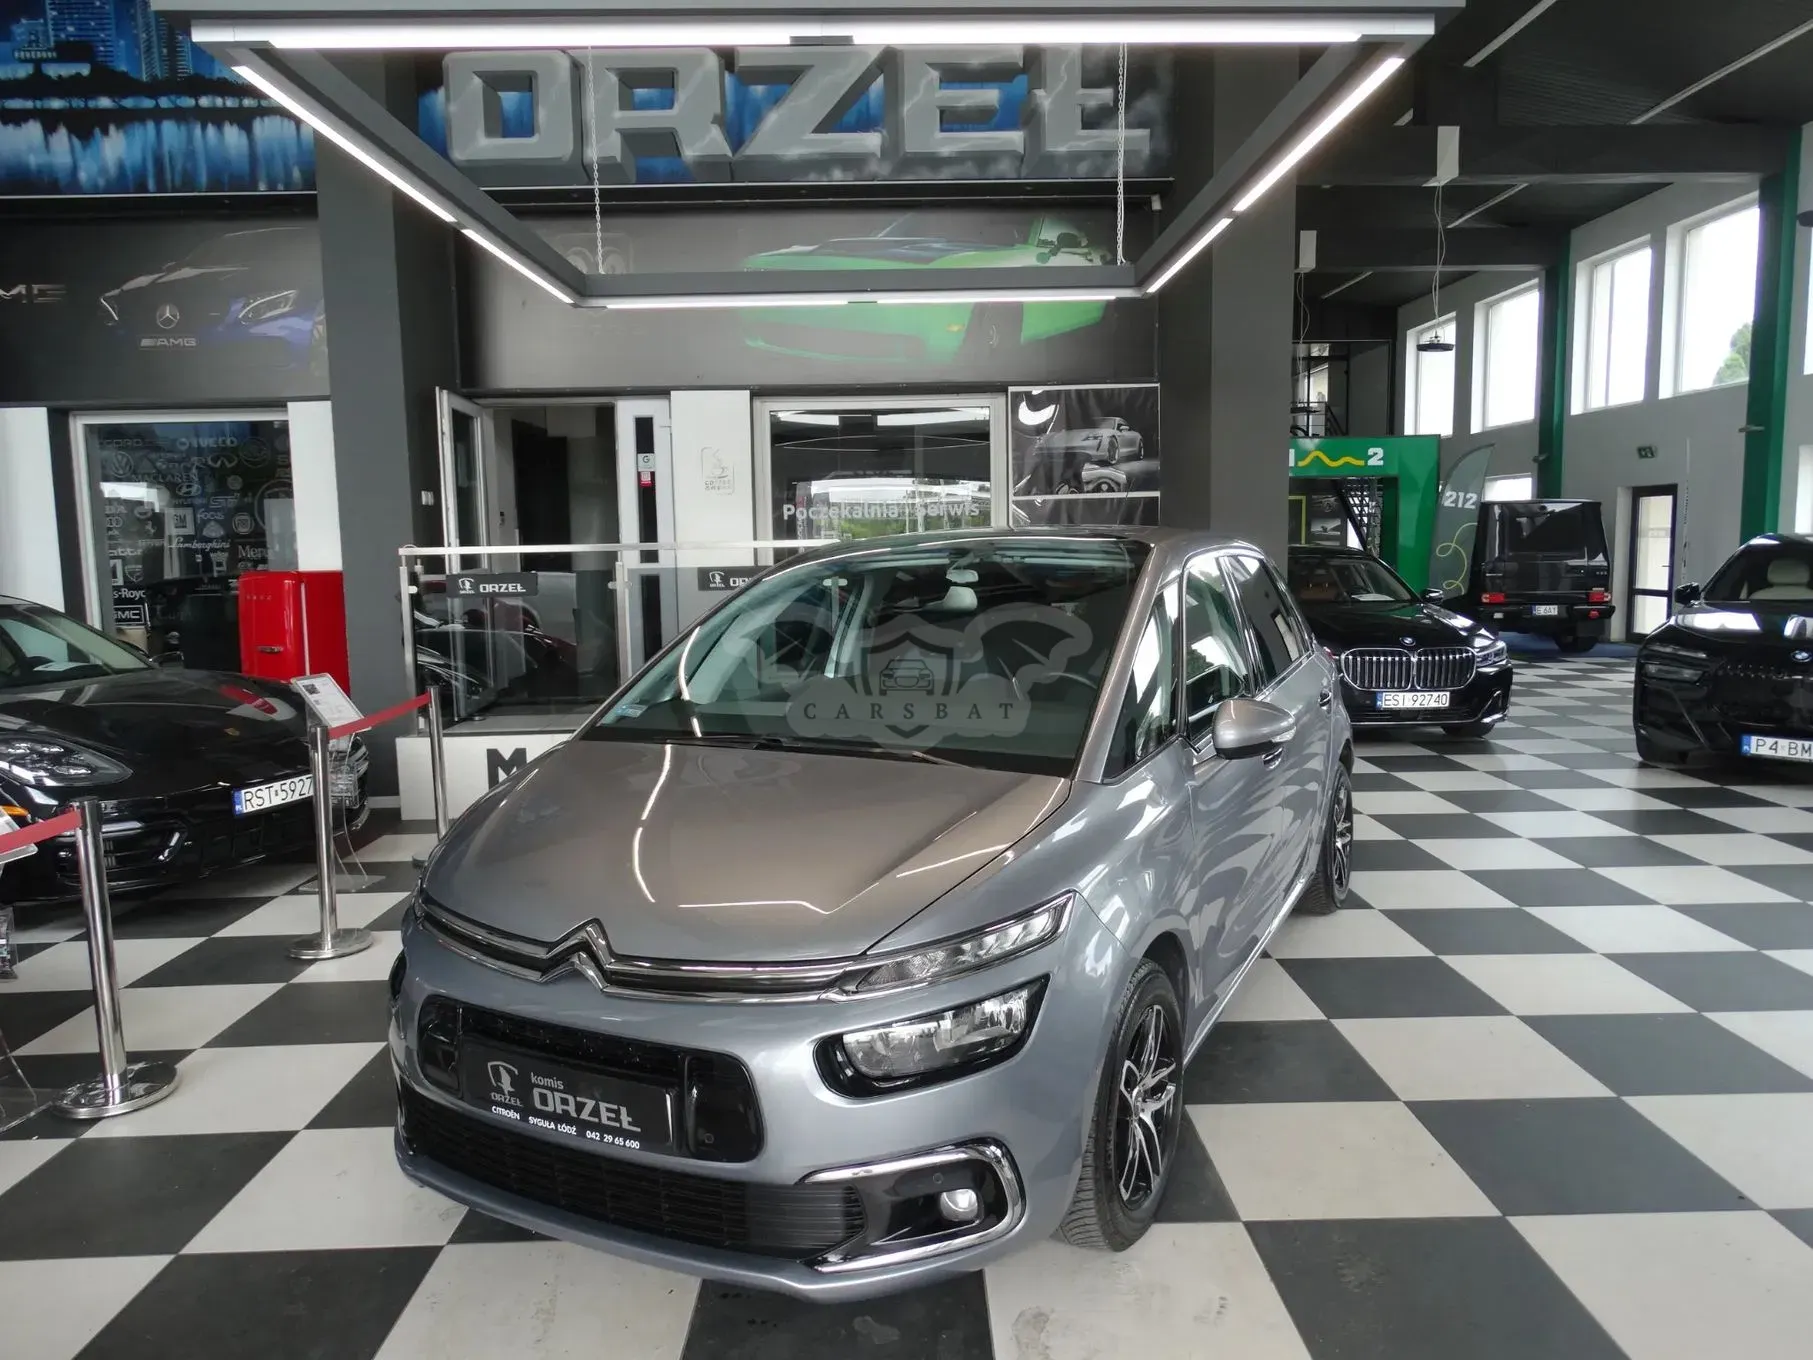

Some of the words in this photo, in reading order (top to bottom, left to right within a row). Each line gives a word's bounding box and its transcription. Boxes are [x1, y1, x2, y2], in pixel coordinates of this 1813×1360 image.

[155, 337, 197, 347] AMG
[1367, 447, 1384, 466] 2
[1443, 492, 1478, 509] 212
[782, 501, 899, 521] Poczekalnia
[1384, 694, 1406, 706] ESI
[1411, 693, 1448, 706] 92740
[1755, 738, 1779, 754] P4
[244, 785, 274, 810] RST
[280, 776, 313, 801] 5927
[531, 1072, 564, 1090] komis
[533, 1087, 642, 1132] ORZEŁ
[557, 1123, 577, 1135] ŁÓDŹ
[586, 1130, 600, 1141] 042
[603, 1133, 613, 1143] 29
[614, 1136, 624, 1146] 65
[625, 1138, 640, 1149] 600
